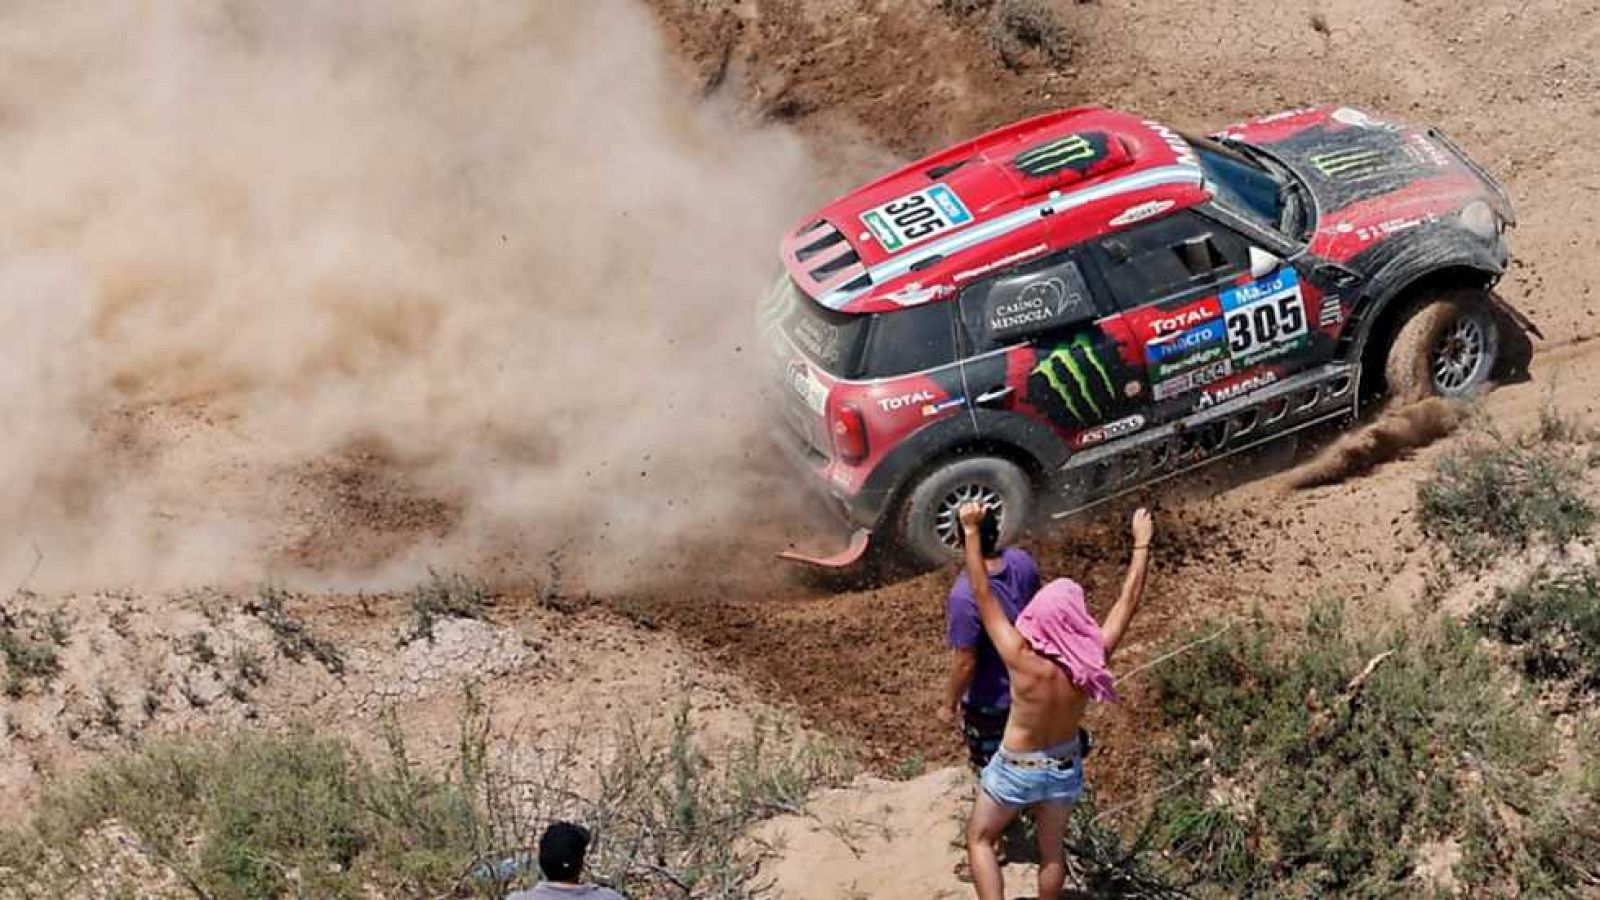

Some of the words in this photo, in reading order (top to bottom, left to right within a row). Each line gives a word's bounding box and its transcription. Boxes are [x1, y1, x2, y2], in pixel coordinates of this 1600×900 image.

[884, 195, 945, 239] 305
[991, 306, 1053, 329] MENDOZA
[996, 296, 1043, 316] CASINO
[1149, 306, 1213, 334] TOTAL
[1228, 295, 1301, 352] 305
[878, 390, 934, 411] TOTAL
